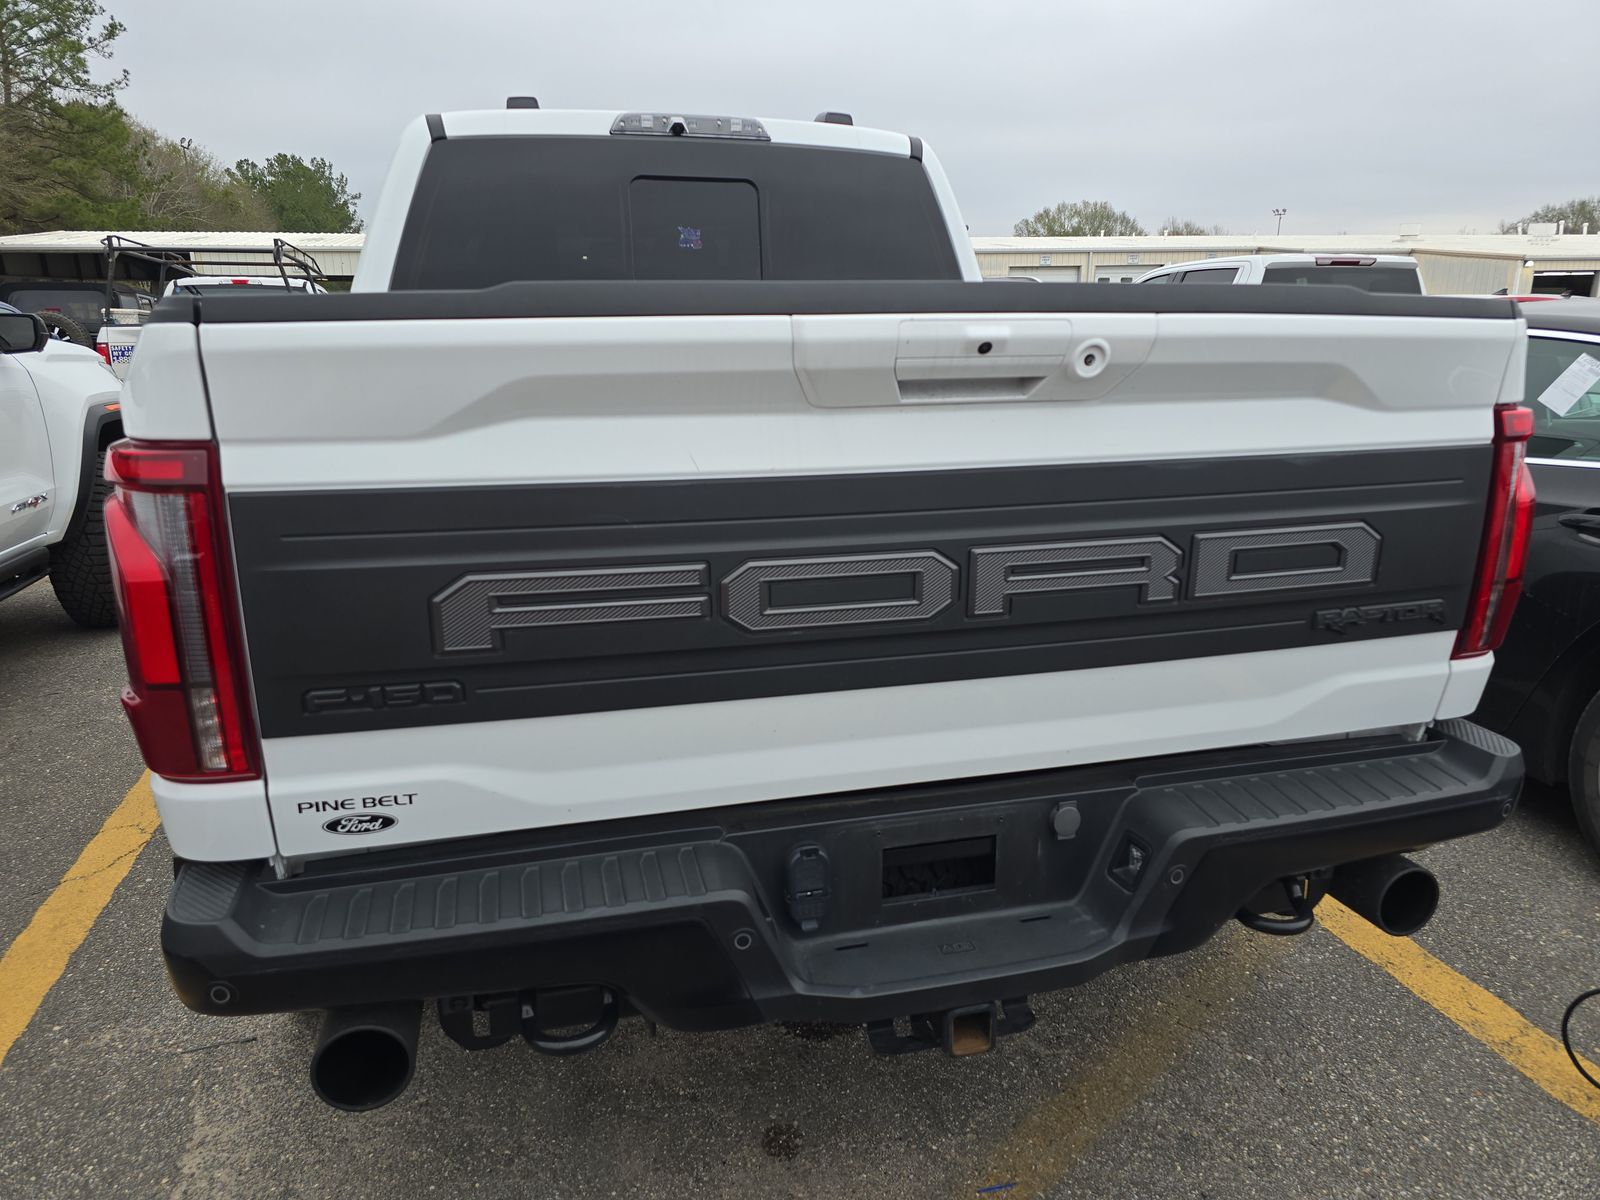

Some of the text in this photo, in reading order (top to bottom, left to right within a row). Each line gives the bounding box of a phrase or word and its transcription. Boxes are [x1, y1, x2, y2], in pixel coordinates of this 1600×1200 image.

[430, 521, 1382, 653] FORD
[1312, 599, 1445, 636] RAPTOR
[302, 679, 466, 715] F-150
[297, 793, 418, 814] PINE BELT
[337, 815, 384, 833] Ford
